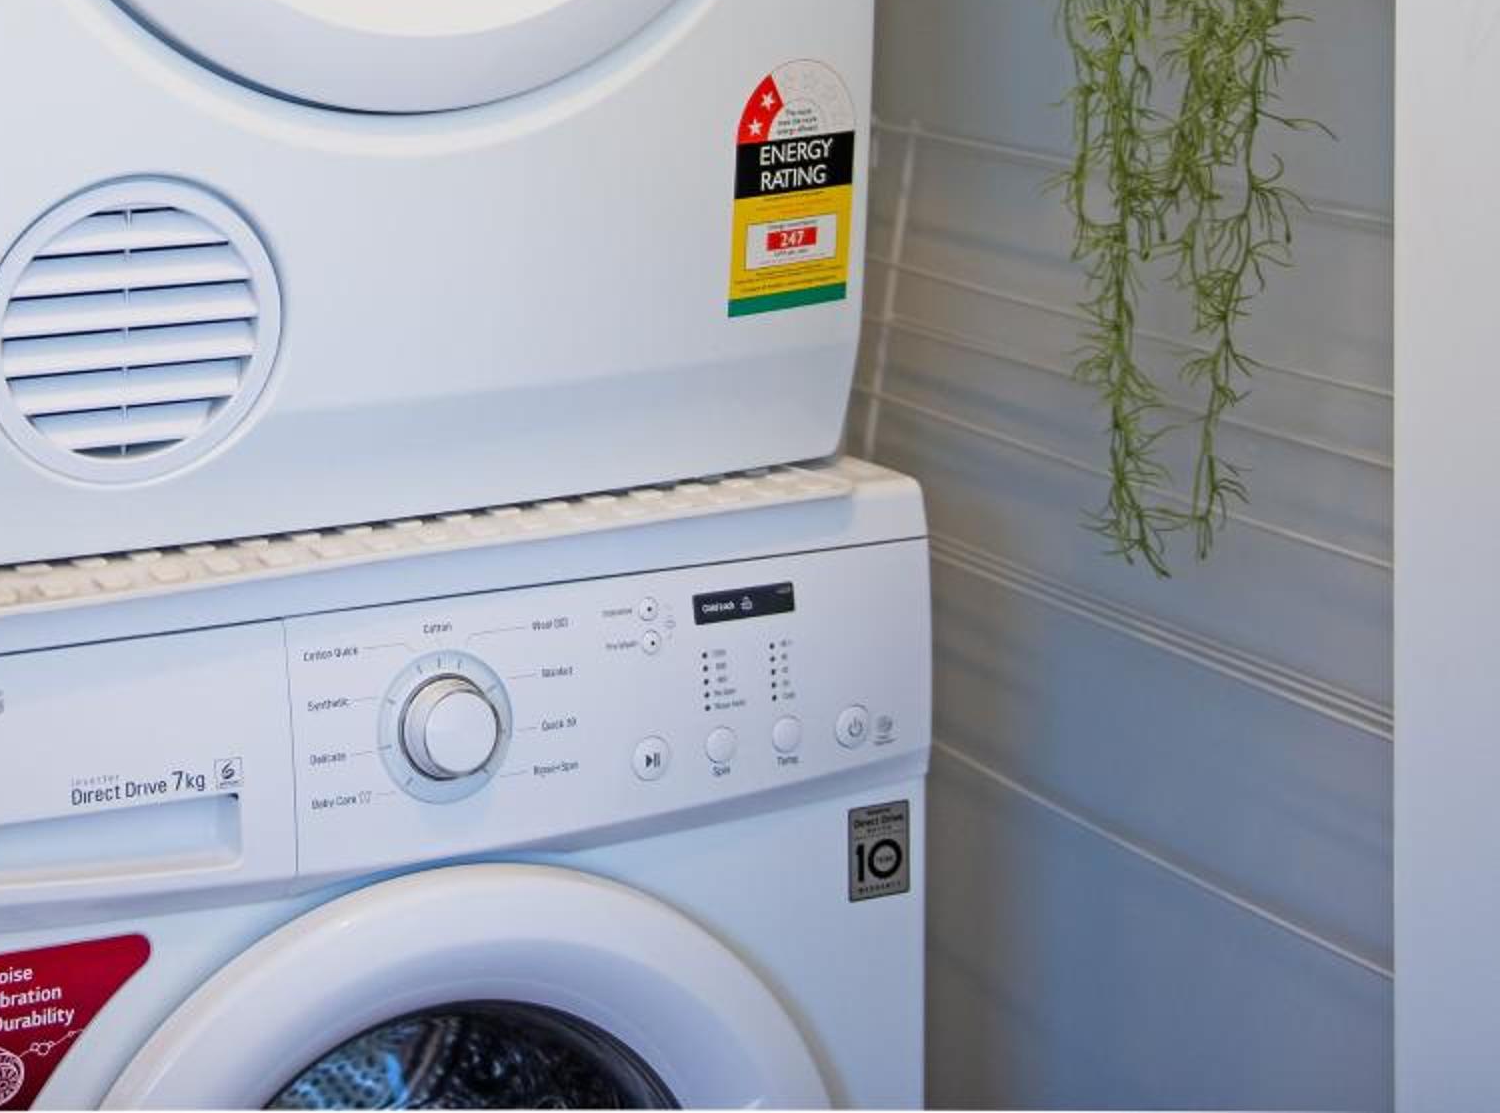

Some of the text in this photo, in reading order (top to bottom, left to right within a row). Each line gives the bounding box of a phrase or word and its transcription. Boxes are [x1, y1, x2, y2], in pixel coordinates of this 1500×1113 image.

[760, 138, 833, 166] ENERGY
[761, 164, 827, 191] RATING
[780, 230, 805, 248] 247
[71, 780, 167, 806] Direct Drive
[172, 770, 206, 792] 7kg
[856, 838, 903, 883] 10
